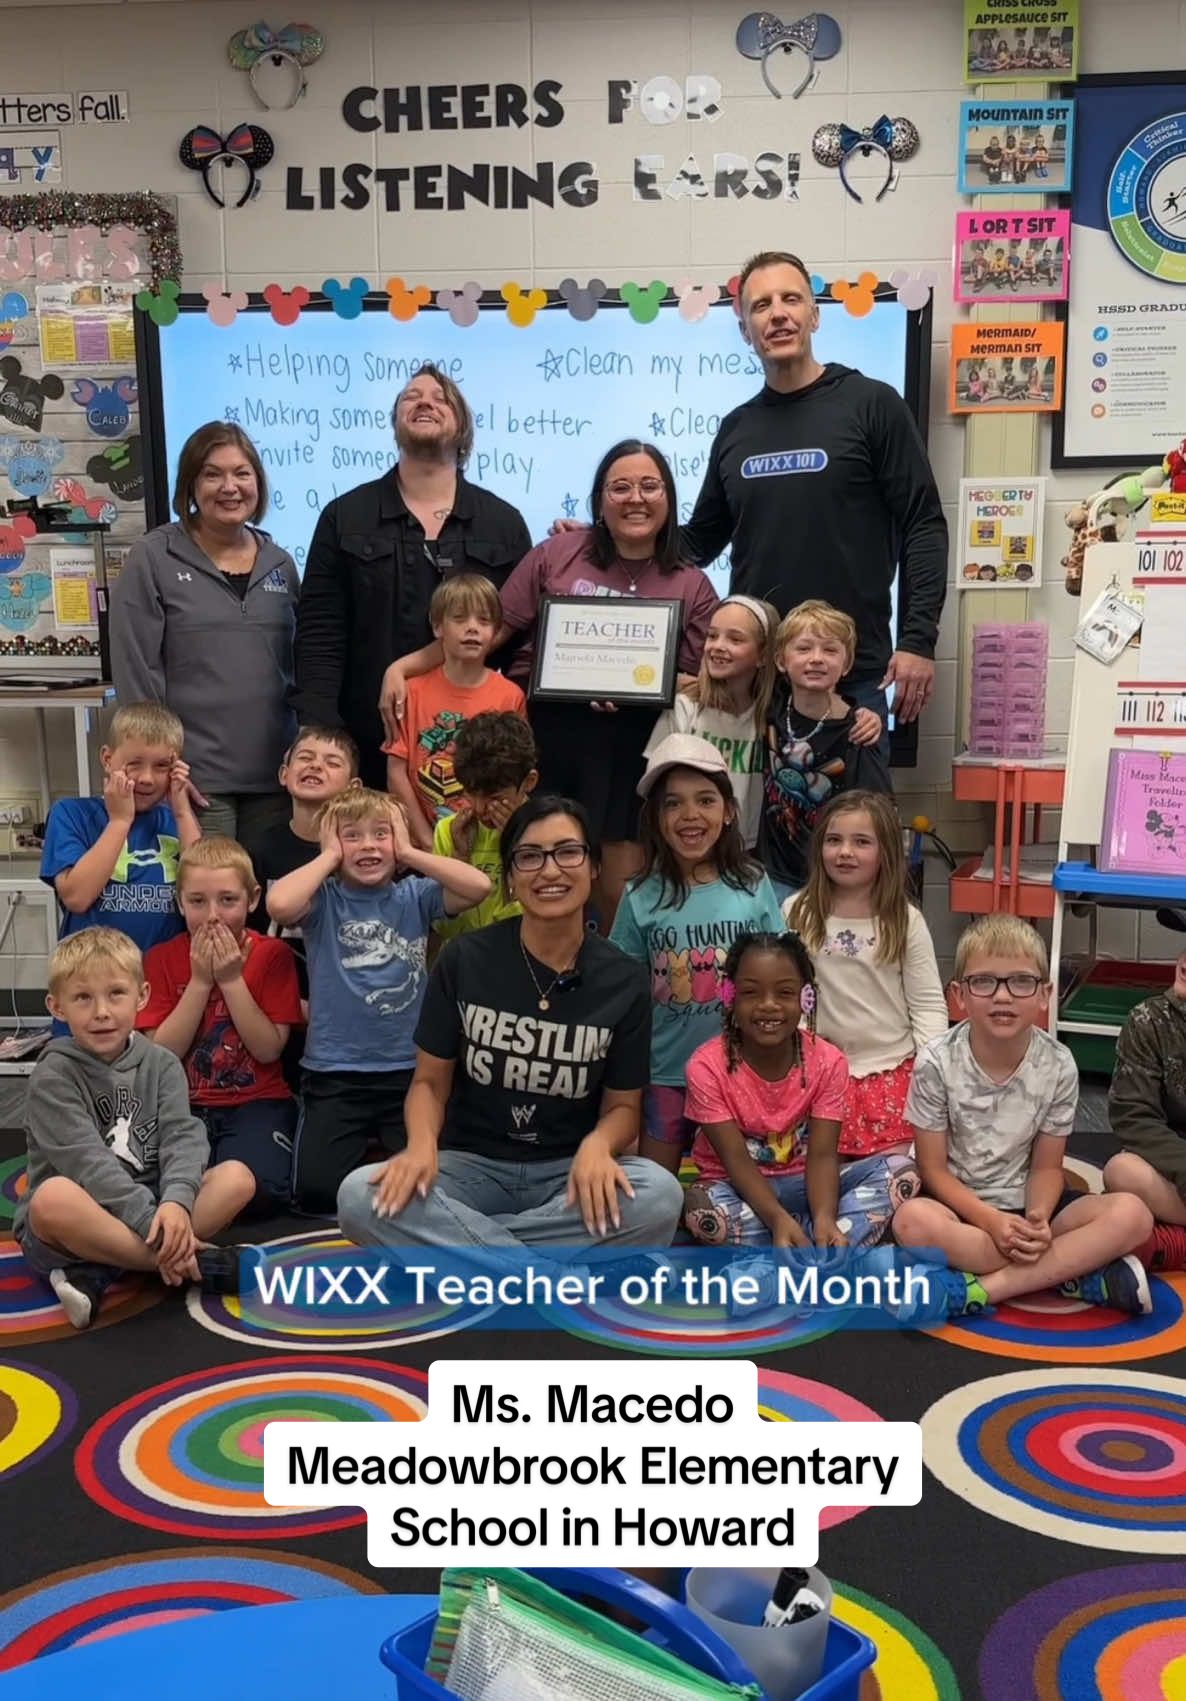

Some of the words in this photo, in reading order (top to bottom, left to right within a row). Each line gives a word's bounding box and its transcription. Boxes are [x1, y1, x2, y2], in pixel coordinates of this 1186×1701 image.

[1050, 12, 1069, 23] SIT
[79, 94, 126, 121] fall.
[342, 79, 564, 134] CHEERS
[608, 75, 724, 124] FOR
[968, 108, 1044, 122] MOUNTAIN
[1046, 107, 1070, 121] SIT
[1143, 121, 1178, 143] Critical
[286, 161, 599, 212] LISTENING
[633, 152, 800, 201] EARS!
[969, 219, 978, 234] L
[983, 218, 1008, 234] OR
[1012, 218, 1024, 233] T
[1027, 217, 1056, 233] SIT
[1097, 304, 1137, 314] HSSD
[1024, 343, 1042, 354] SIT
[245, 343, 351, 393] Helping
[566, 346, 633, 376] Clean
[650, 356, 683, 393] my
[244, 397, 321, 442] Making
[507, 404, 593, 438] better
[670, 407, 719, 438] Clea
[252, 440, 315, 466] nvite
[331, 445, 397, 471] someo
[477, 448, 534, 494] play
[747, 454, 794, 474] WIXX
[796, 453, 818, 469] 101
[1138, 550, 1156, 572] 101
[1162, 550, 1184, 572] 102
[561, 620, 656, 639] TEACHER
[1121, 700, 1138, 723] 111
[1146, 700, 1165, 723] 112
[102, 883, 177, 901] UNDE
[466, 1044, 494, 1086] IS
[502, 1055, 591, 1100] REAL
